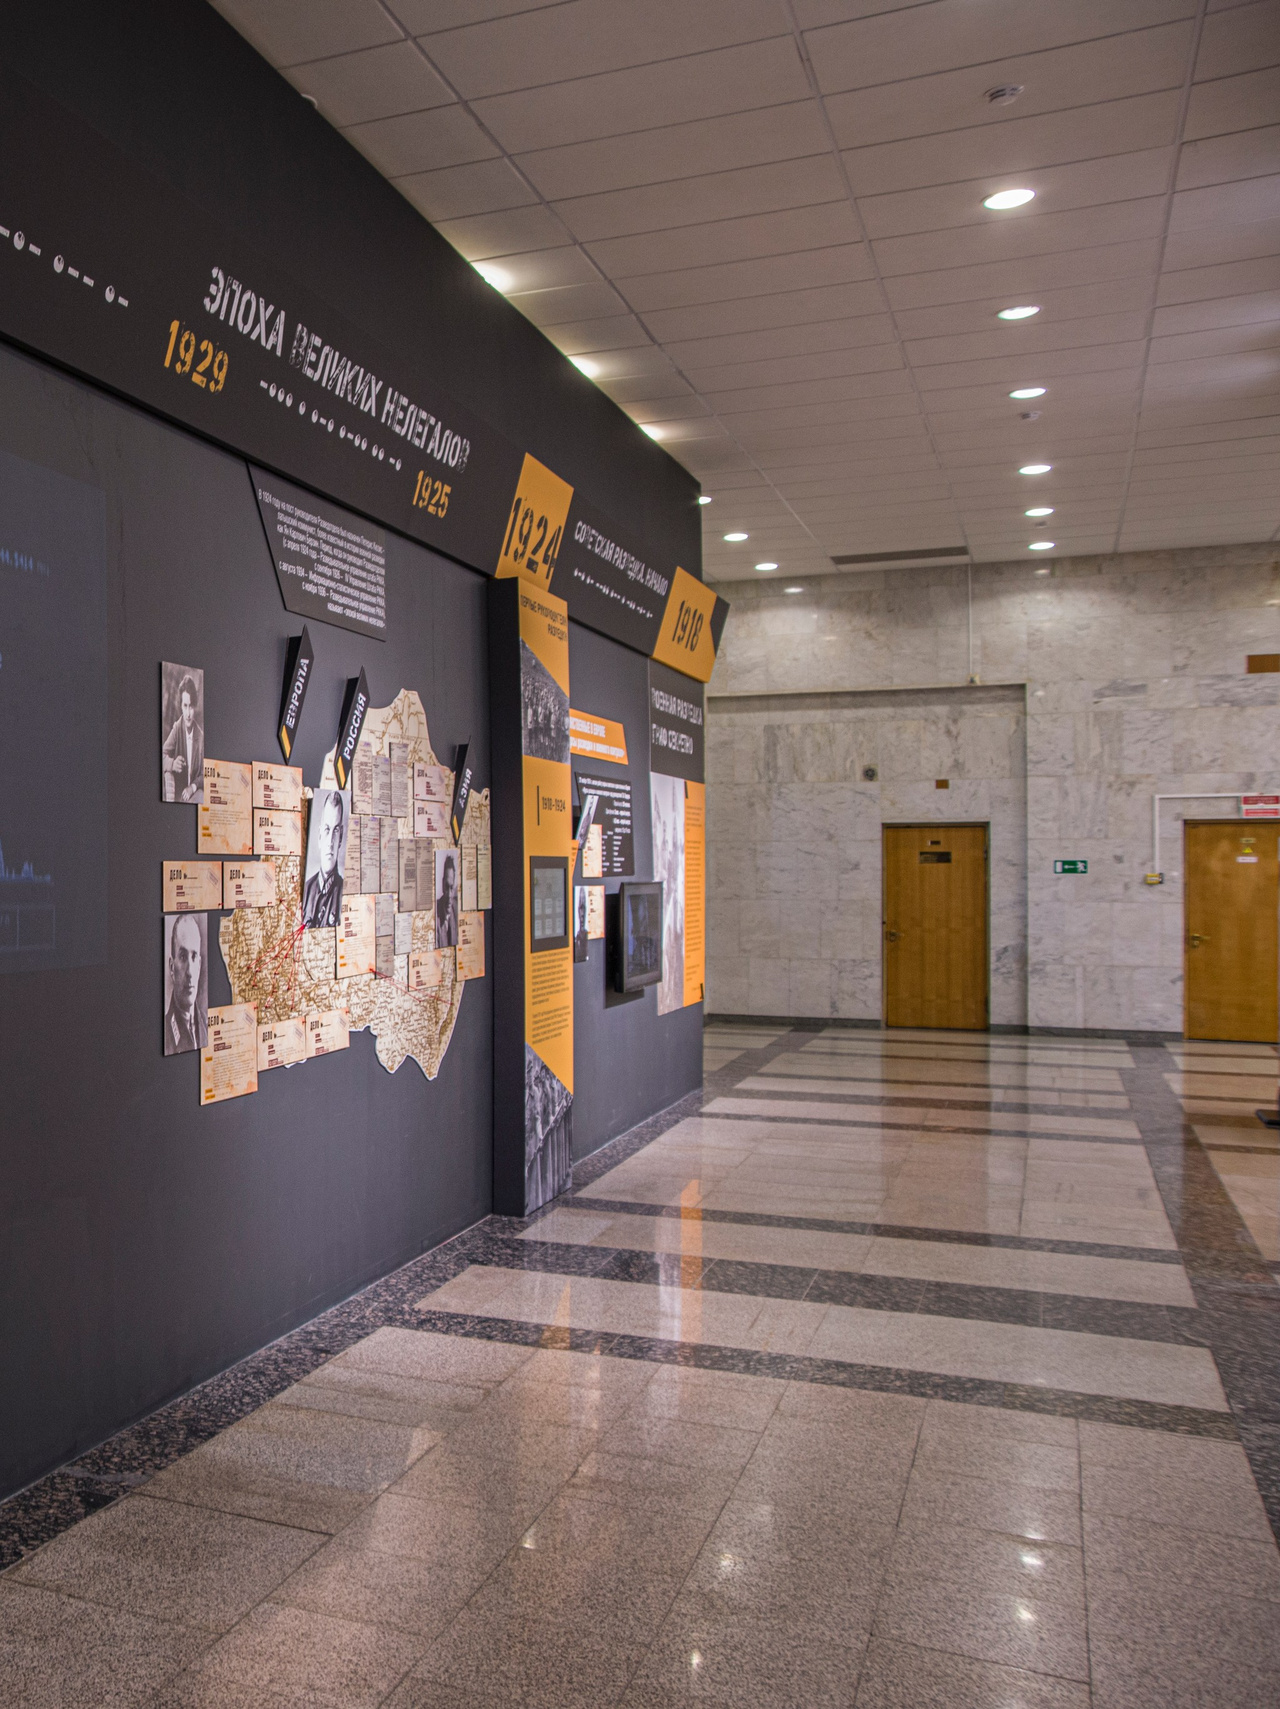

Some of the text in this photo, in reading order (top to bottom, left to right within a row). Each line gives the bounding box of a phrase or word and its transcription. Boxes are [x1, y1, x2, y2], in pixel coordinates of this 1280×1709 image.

[163, 319, 229, 394] 1929
[203, 266, 470, 474] ЭПОХА ВЕЛИКИХ НЕЛЕГАЛОВ
[412, 469, 452, 518] 1925
[503, 496, 562, 580] 1924
[672, 600, 704, 652] 1918
[285, 658, 310, 729] ЕВРОПА
[342, 692, 367, 761] РОССИЯ
